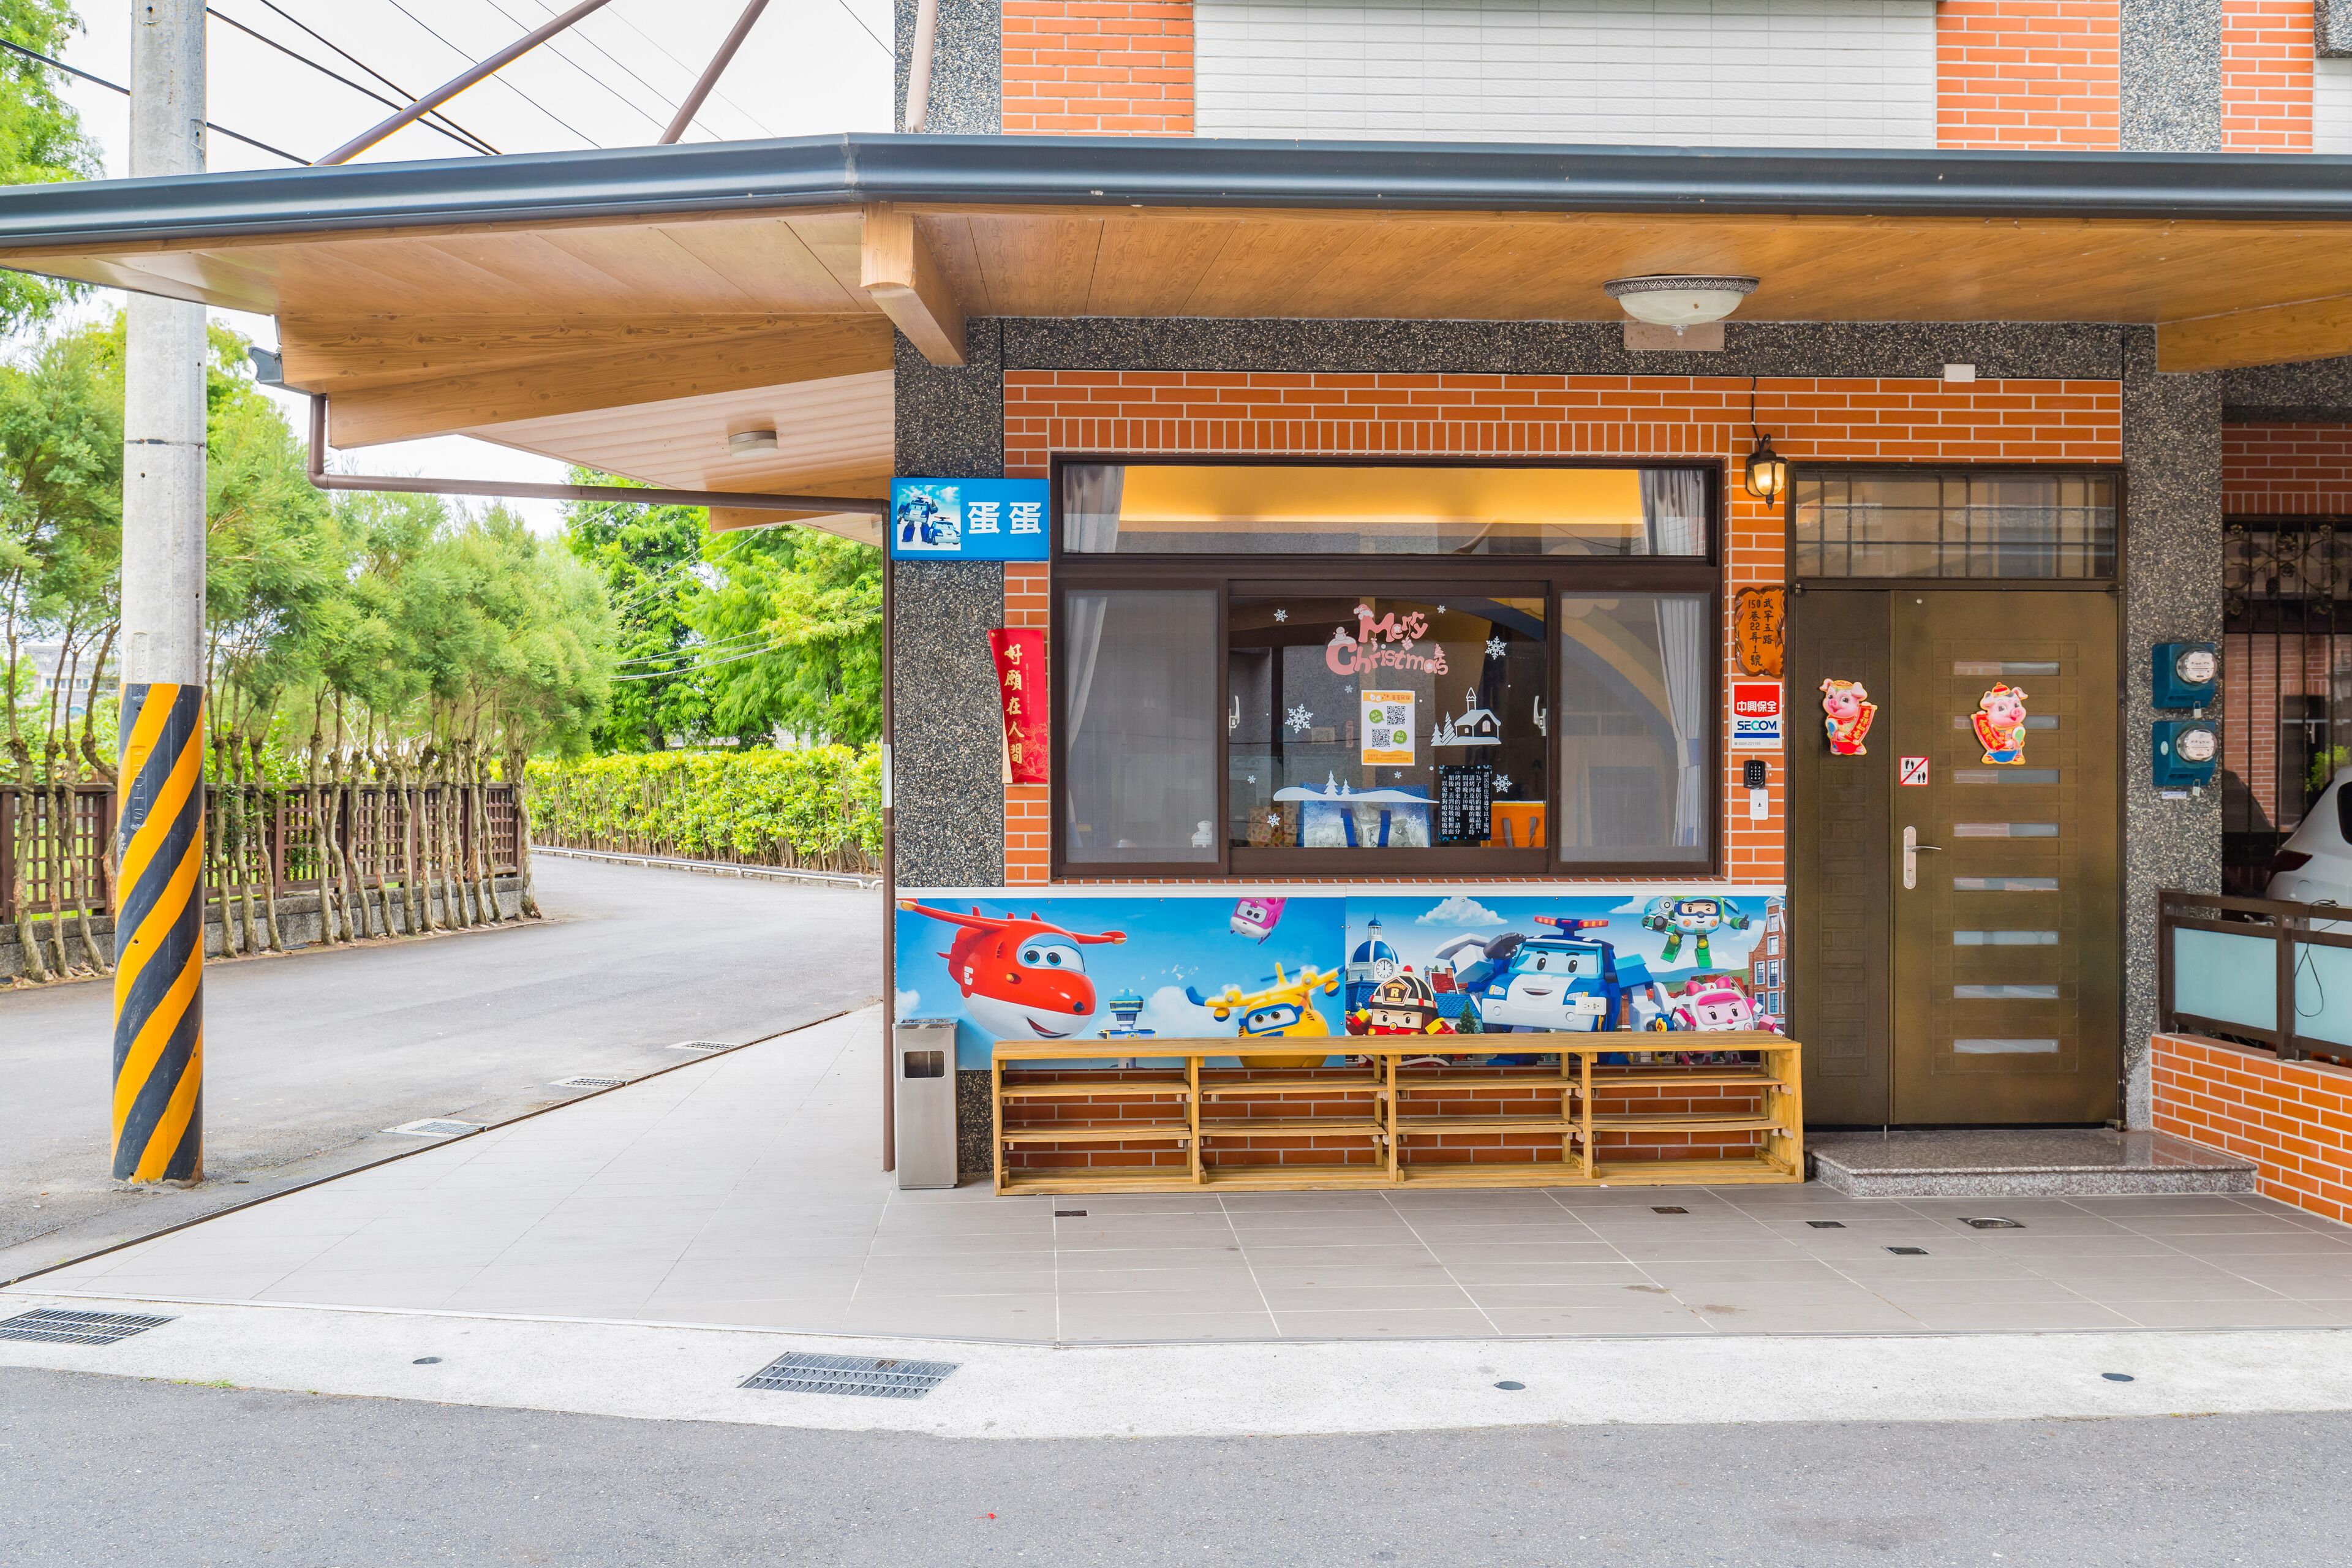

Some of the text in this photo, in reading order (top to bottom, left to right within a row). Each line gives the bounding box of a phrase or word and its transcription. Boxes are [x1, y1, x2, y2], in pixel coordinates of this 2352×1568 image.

[967, 502, 1042, 534] 蛋蛋
[1358, 611, 1428, 643] Merry
[1763, 598, 1774, 644] 武罕五路
[1325, 636, 1449, 676] Christmas
[1004, 644, 1025, 764] 好願在人間
[1736, 700, 1777, 712] 中興保全
[1737, 720, 1777, 731] SECOM
[1390, 987, 1399, 997] R
